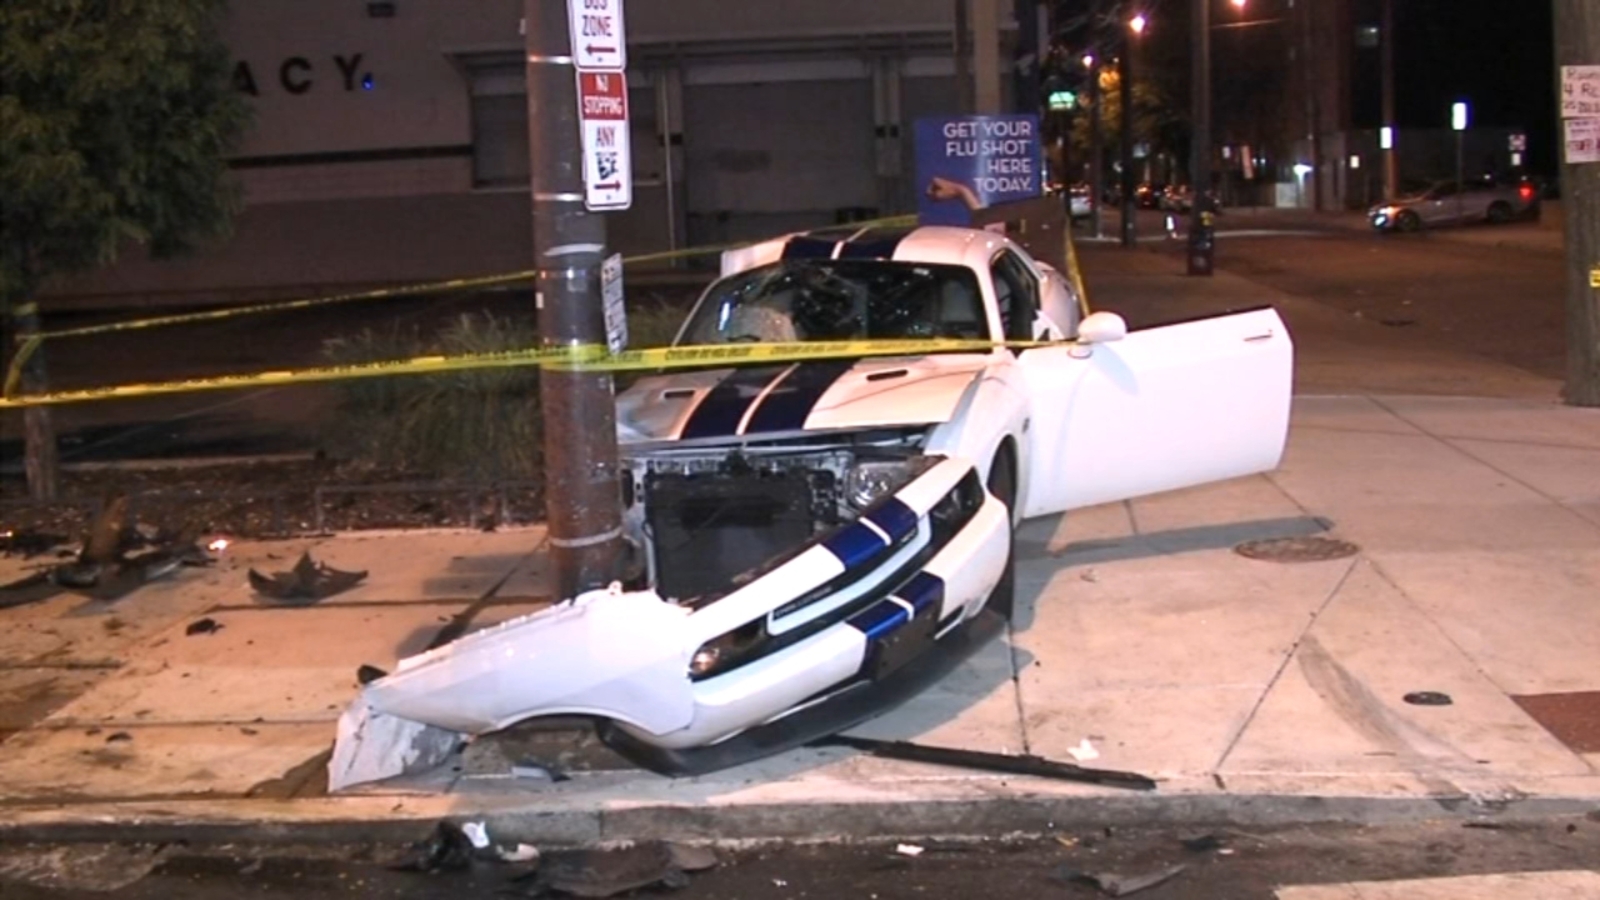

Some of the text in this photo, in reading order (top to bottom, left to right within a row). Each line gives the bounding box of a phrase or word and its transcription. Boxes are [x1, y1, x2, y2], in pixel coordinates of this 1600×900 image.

[582, 14, 612, 37] ZONE
[584, 95, 623, 115] STOPPING
[595, 126, 615, 147] ANY
[943, 121, 1032, 138] GET YOUR
[945, 140, 1031, 157] FLU SHOT
[987, 158, 1032, 174] HERE
[973, 177, 1033, 193] TODAY.
